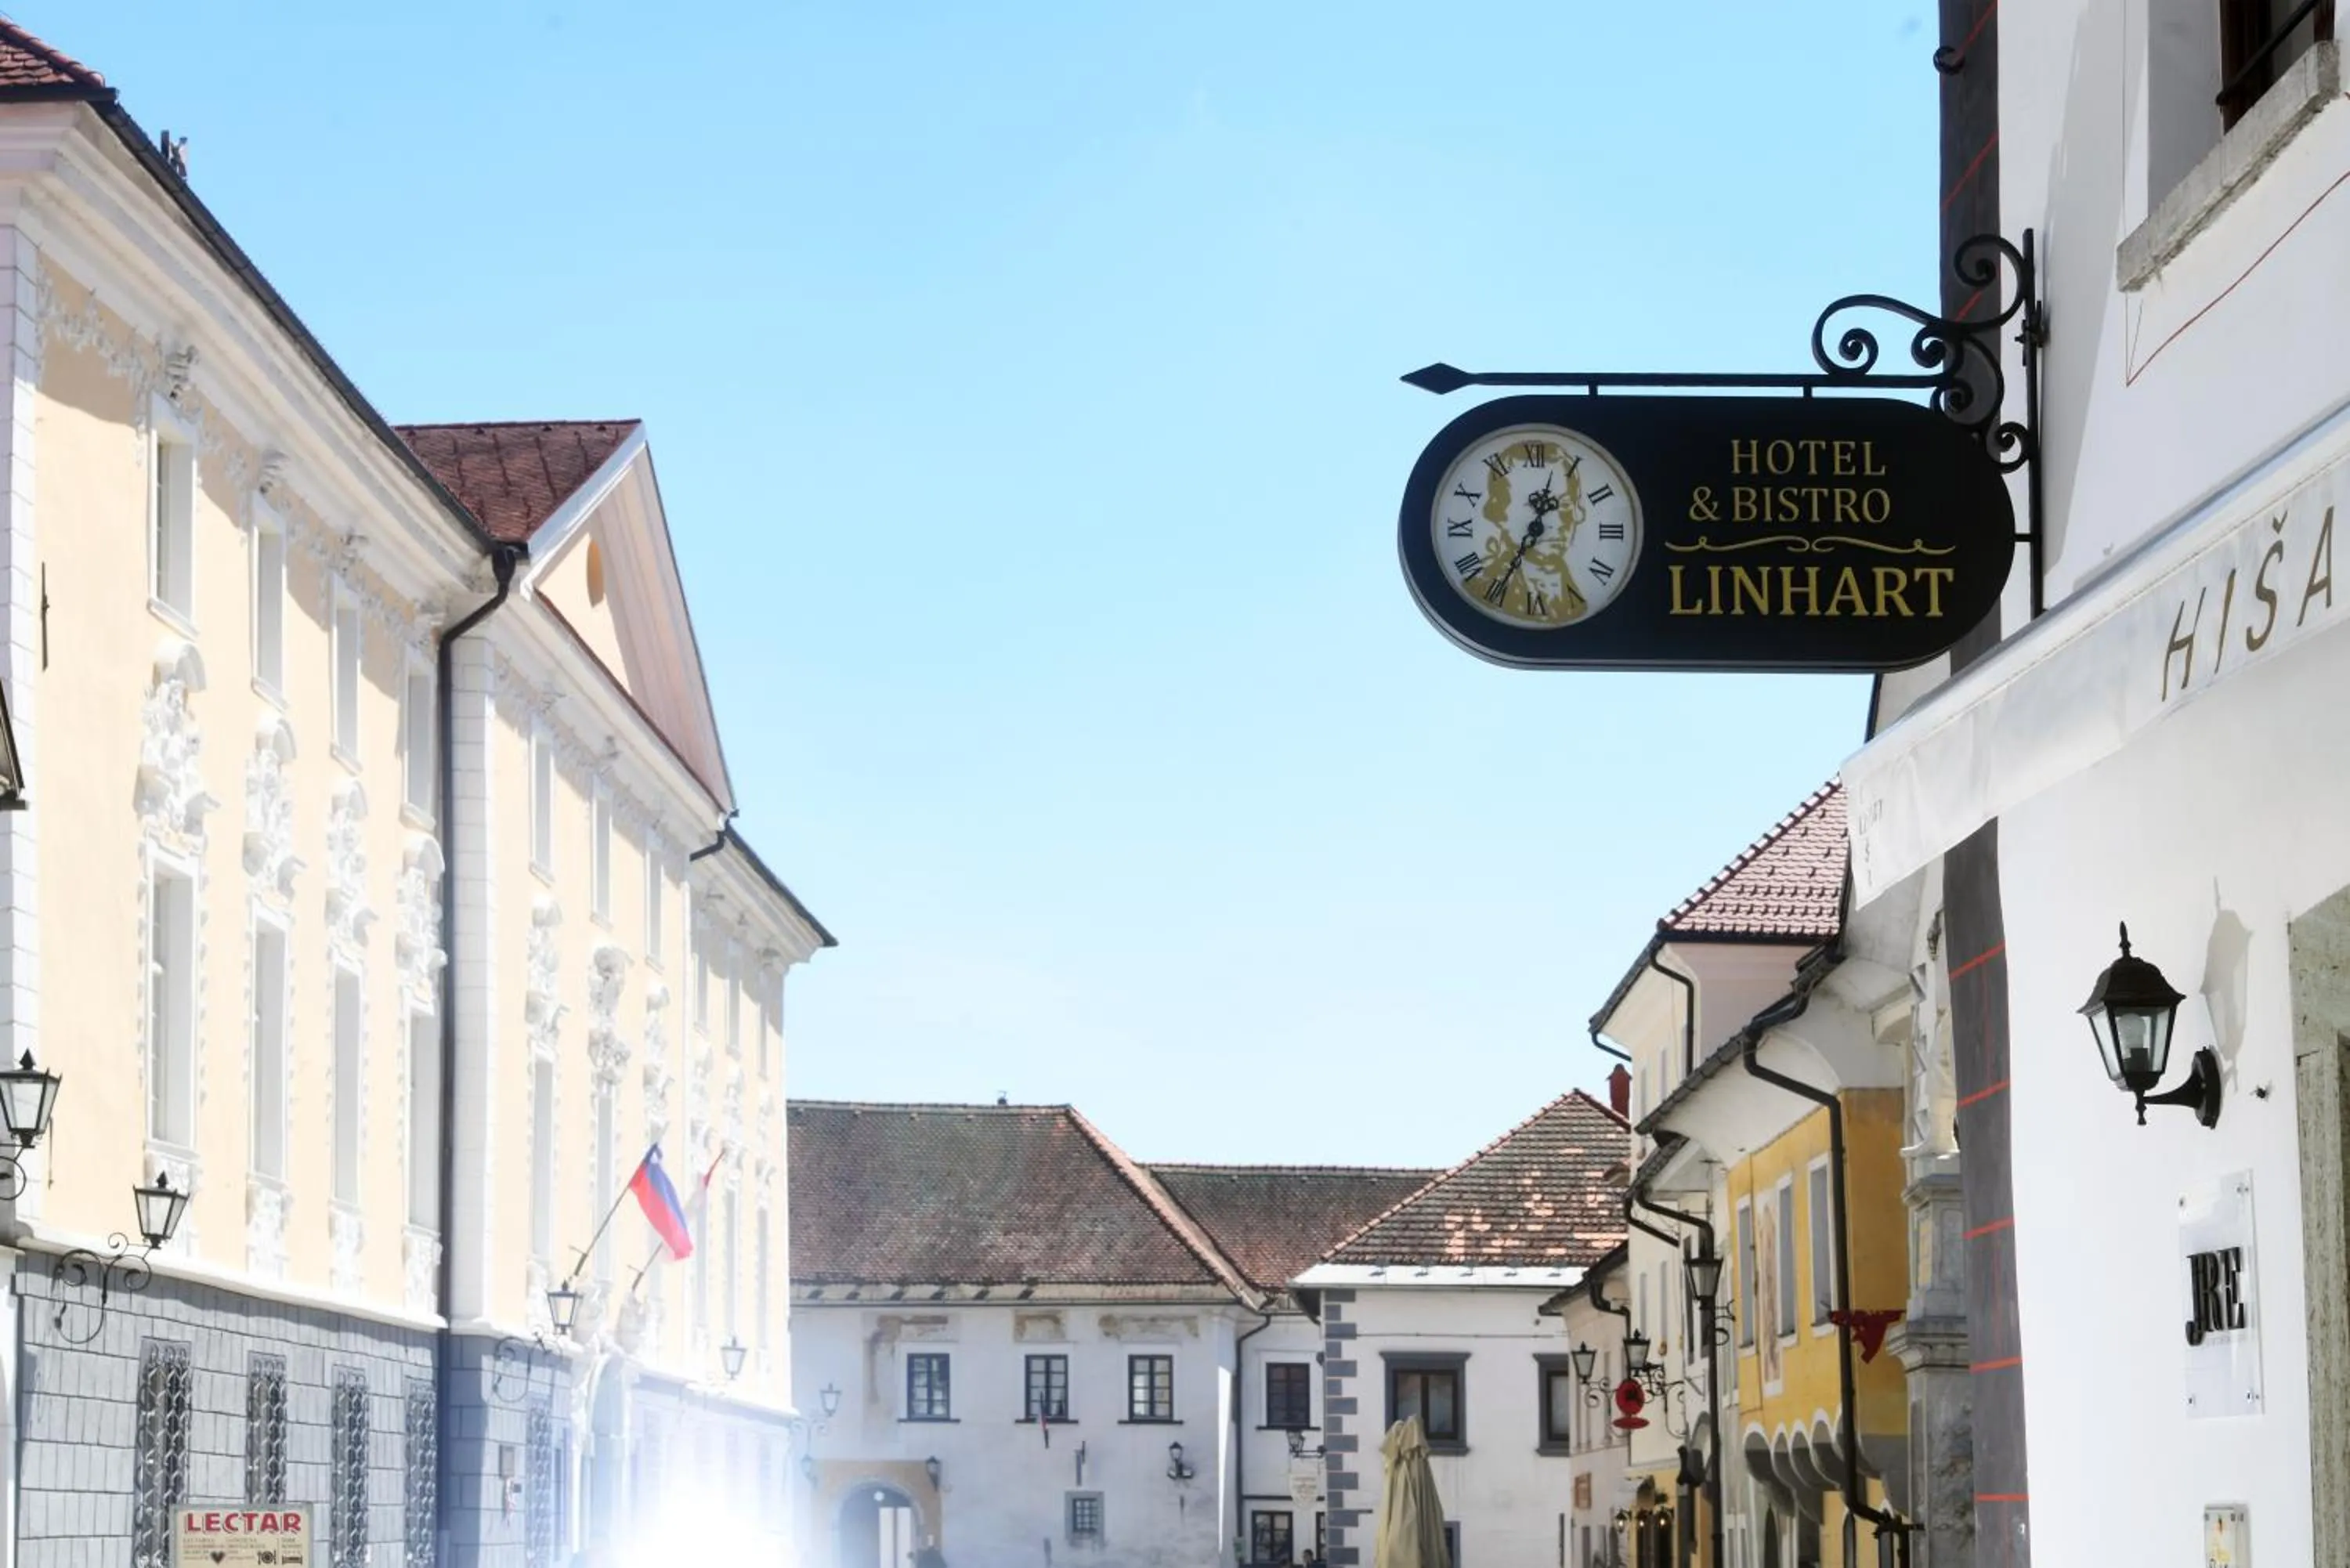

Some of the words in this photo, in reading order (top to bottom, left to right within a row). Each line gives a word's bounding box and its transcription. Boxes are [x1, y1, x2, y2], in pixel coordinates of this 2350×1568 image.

[1482, 453, 1509, 478] XI
[1523, 443, 1546, 468] XII
[1731, 439, 1886, 476] HOTEL
[1454, 482, 1481, 508] X
[1587, 483, 1615, 506] II
[1689, 486, 1721, 522] &
[1732, 486, 1891, 523] BISTRO
[1448, 516, 1473, 539] IX
[1599, 522, 1624, 541] III
[1454, 551, 1484, 583] VIII
[1668, 565, 1954, 617] LINHART
[2161, 505, 2334, 703] HIŠA
[2186, 1246, 2245, 1346] JRE
[185, 1512, 302, 1534] LECTAR
